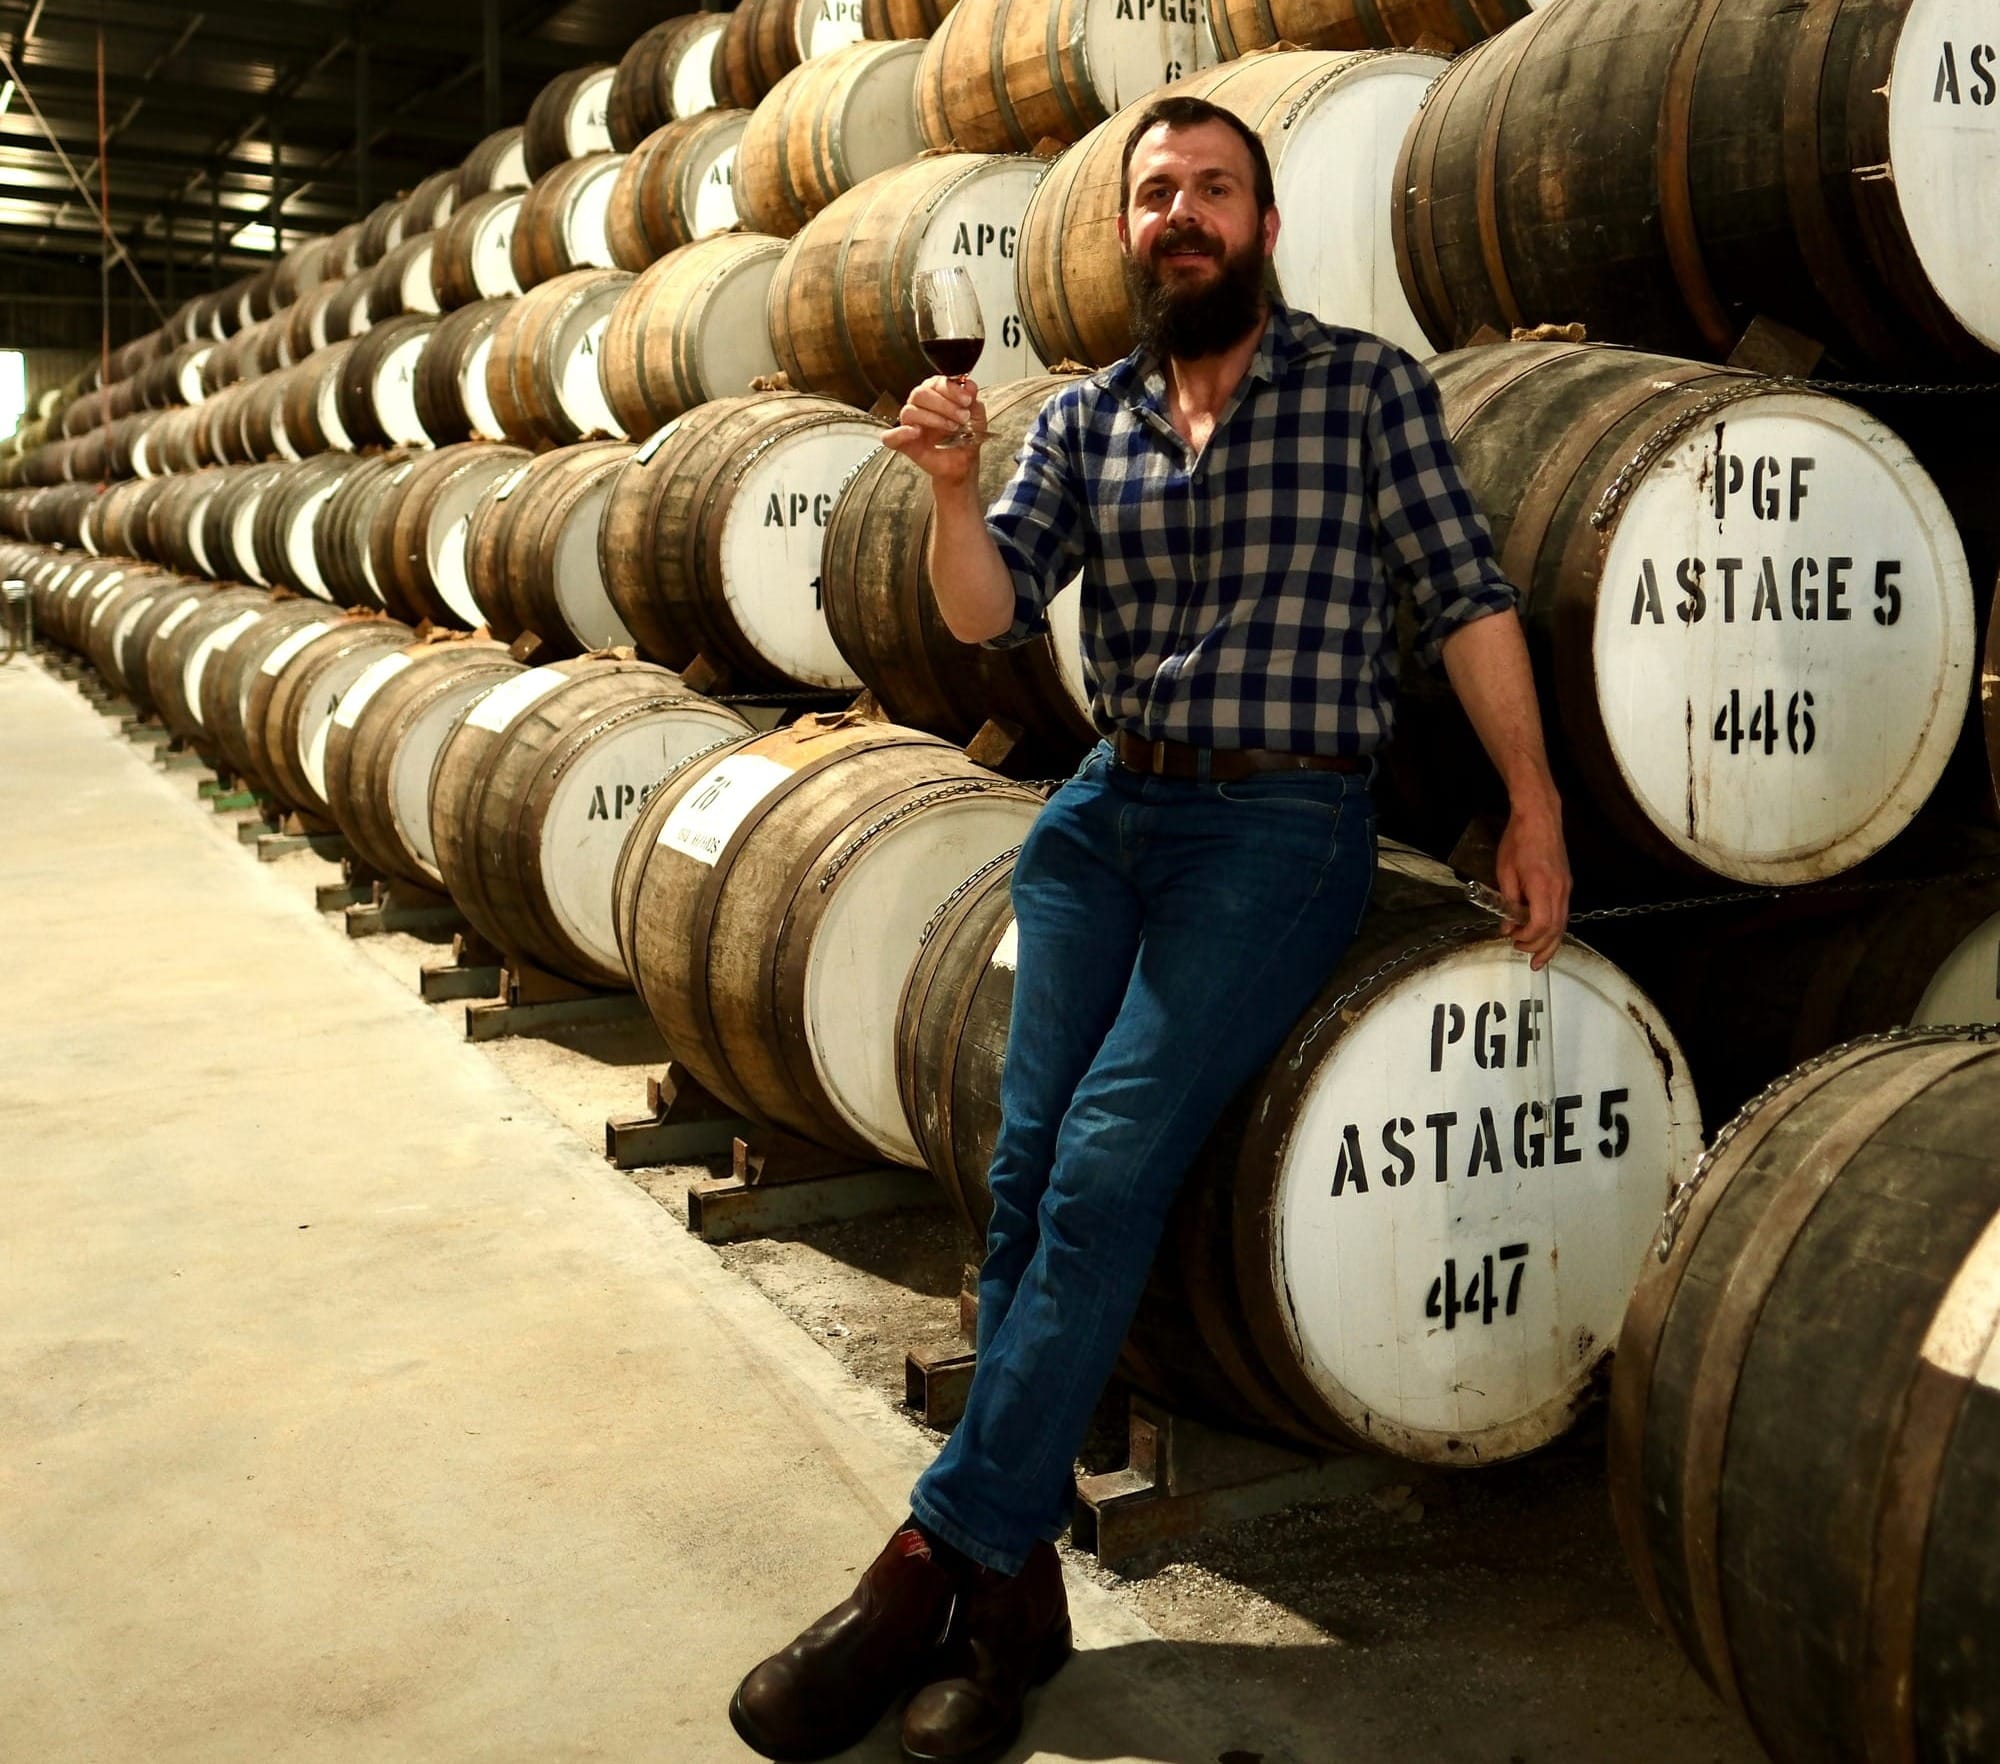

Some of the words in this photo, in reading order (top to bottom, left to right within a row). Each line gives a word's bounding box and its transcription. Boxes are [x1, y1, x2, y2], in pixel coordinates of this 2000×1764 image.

[1116, 0, 1206, 24] APGG
[1932, 41, 1996, 106] AS
[952, 222, 1016, 259] APG
[1002, 314, 1020, 348] 6
[1713, 456, 1816, 522] PGF
[1630, 556, 1854, 627] ASTAGE
[1873, 560, 1902, 627] 5
[1713, 689, 1816, 756] 446
[1429, 997, 1545, 1074] PGF
[1330, 1094, 1584, 1198] ASTAGE
[1597, 1087, 1630, 1160] 5
[1425, 1241, 1530, 1332] 447
